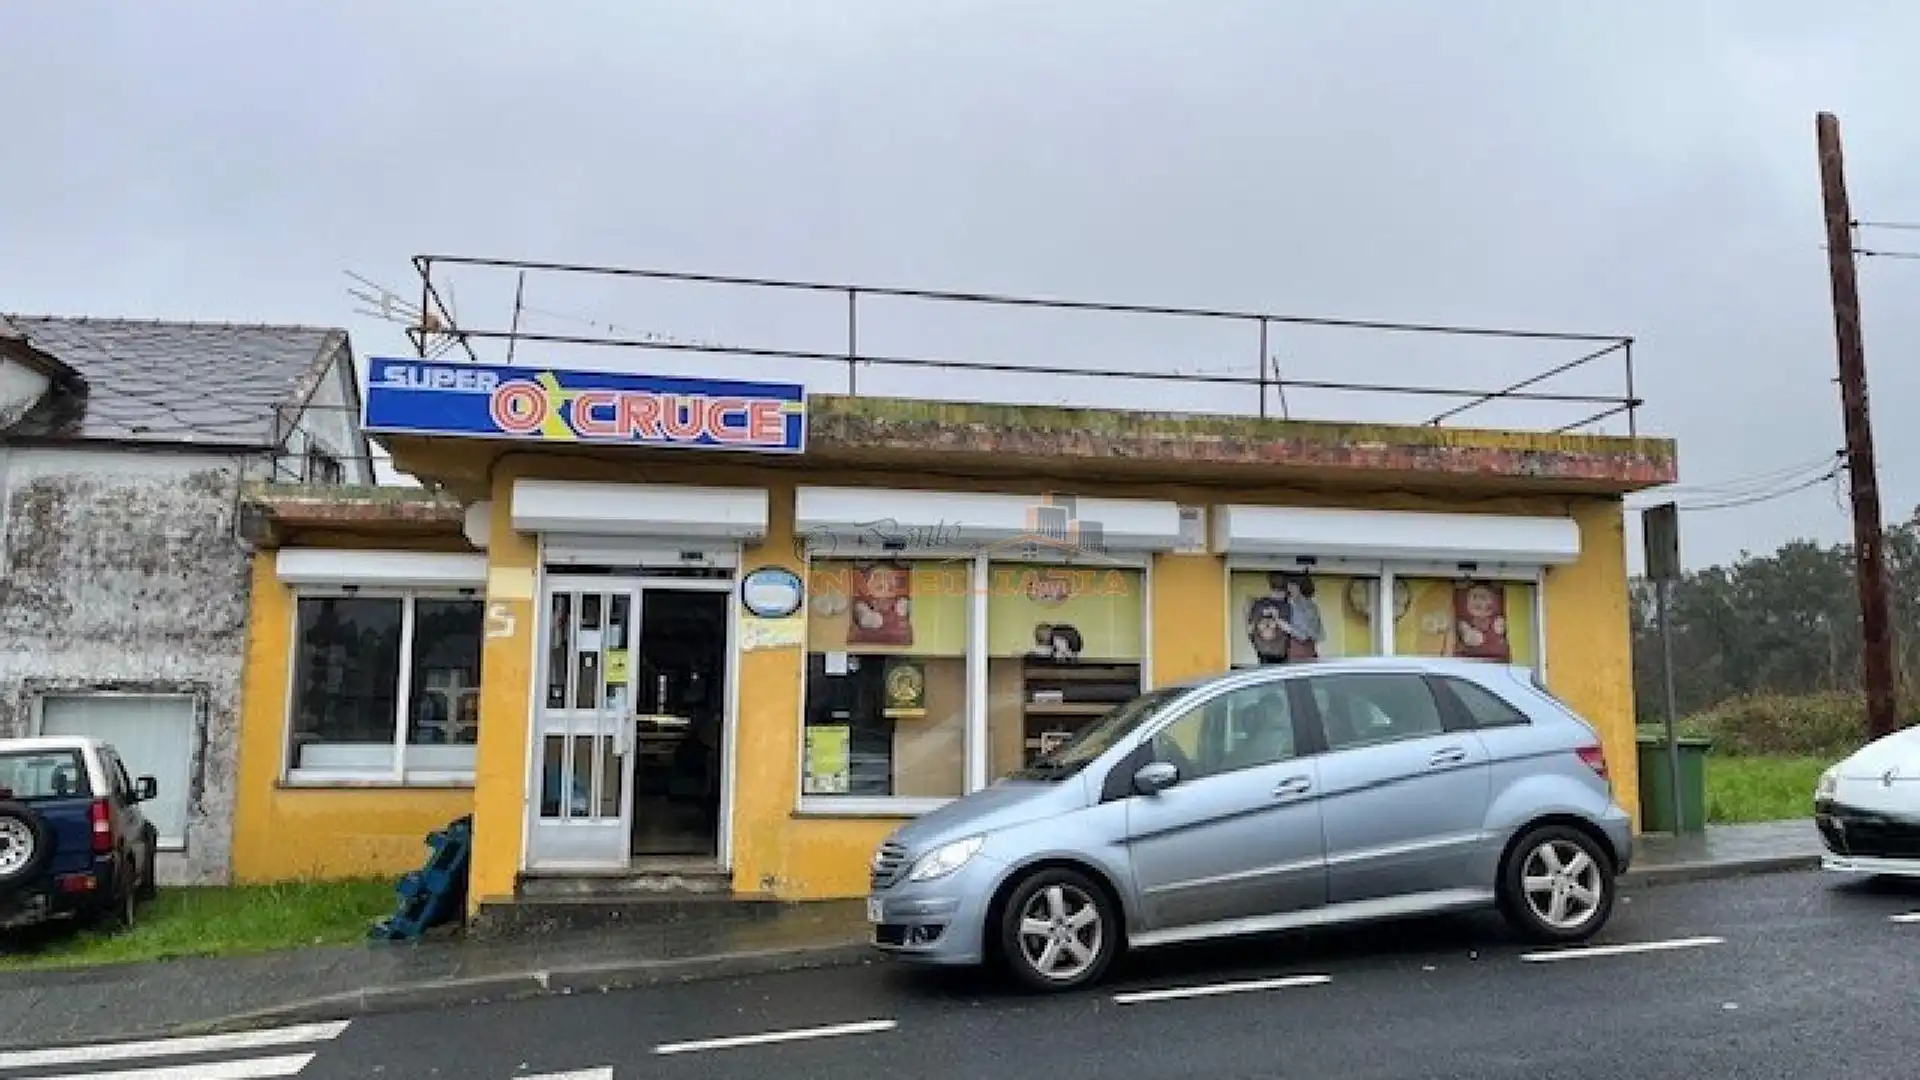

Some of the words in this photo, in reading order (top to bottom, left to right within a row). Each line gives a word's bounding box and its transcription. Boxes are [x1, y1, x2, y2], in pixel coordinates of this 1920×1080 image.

[384, 366, 499, 392] SUPER
[490, 380, 547, 433] O
[571, 390, 786, 444] CRUCE
